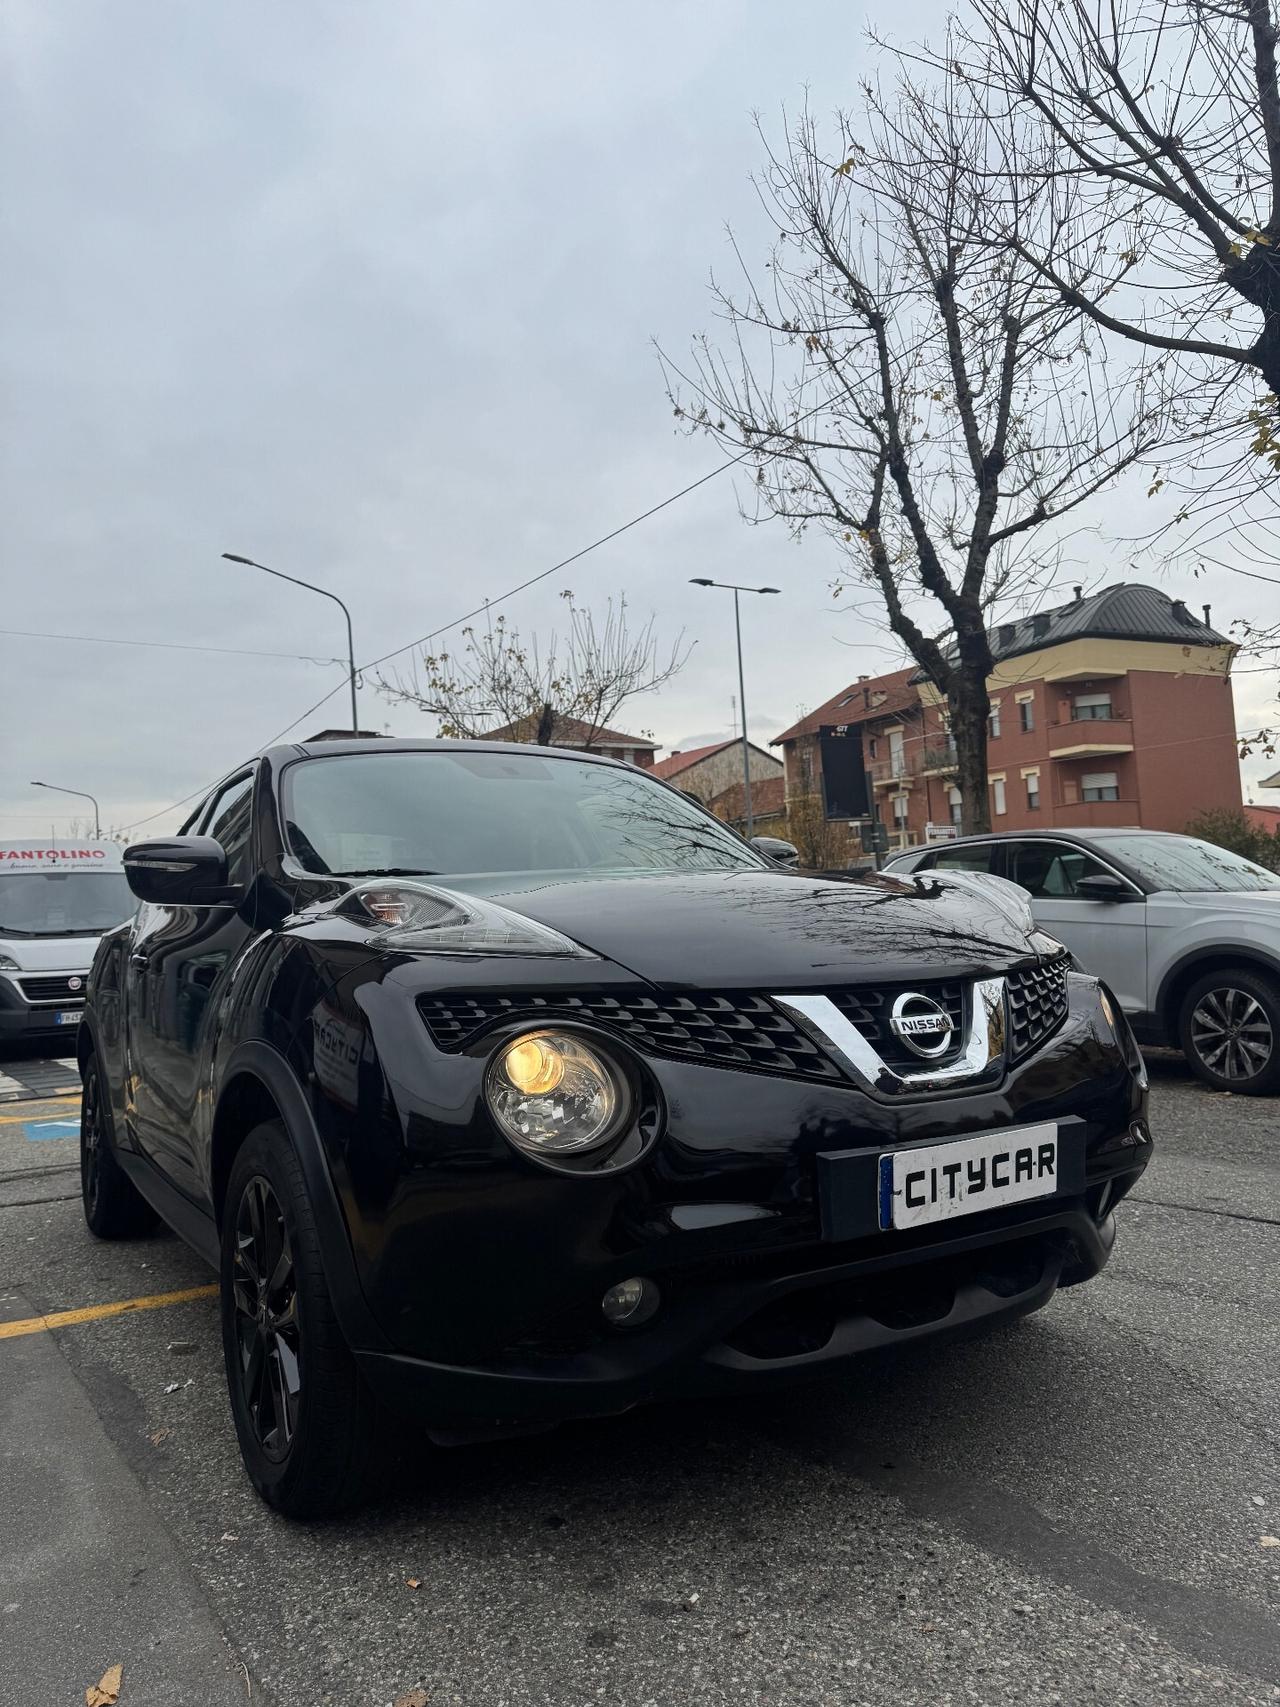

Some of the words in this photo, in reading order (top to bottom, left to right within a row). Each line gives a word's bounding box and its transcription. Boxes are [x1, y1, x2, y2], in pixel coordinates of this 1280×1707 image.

[0, 850, 105, 860] FANTOLINO
[901, 1018, 949, 1031] NISSAN
[905, 1142, 1056, 1209] CITYCAR
